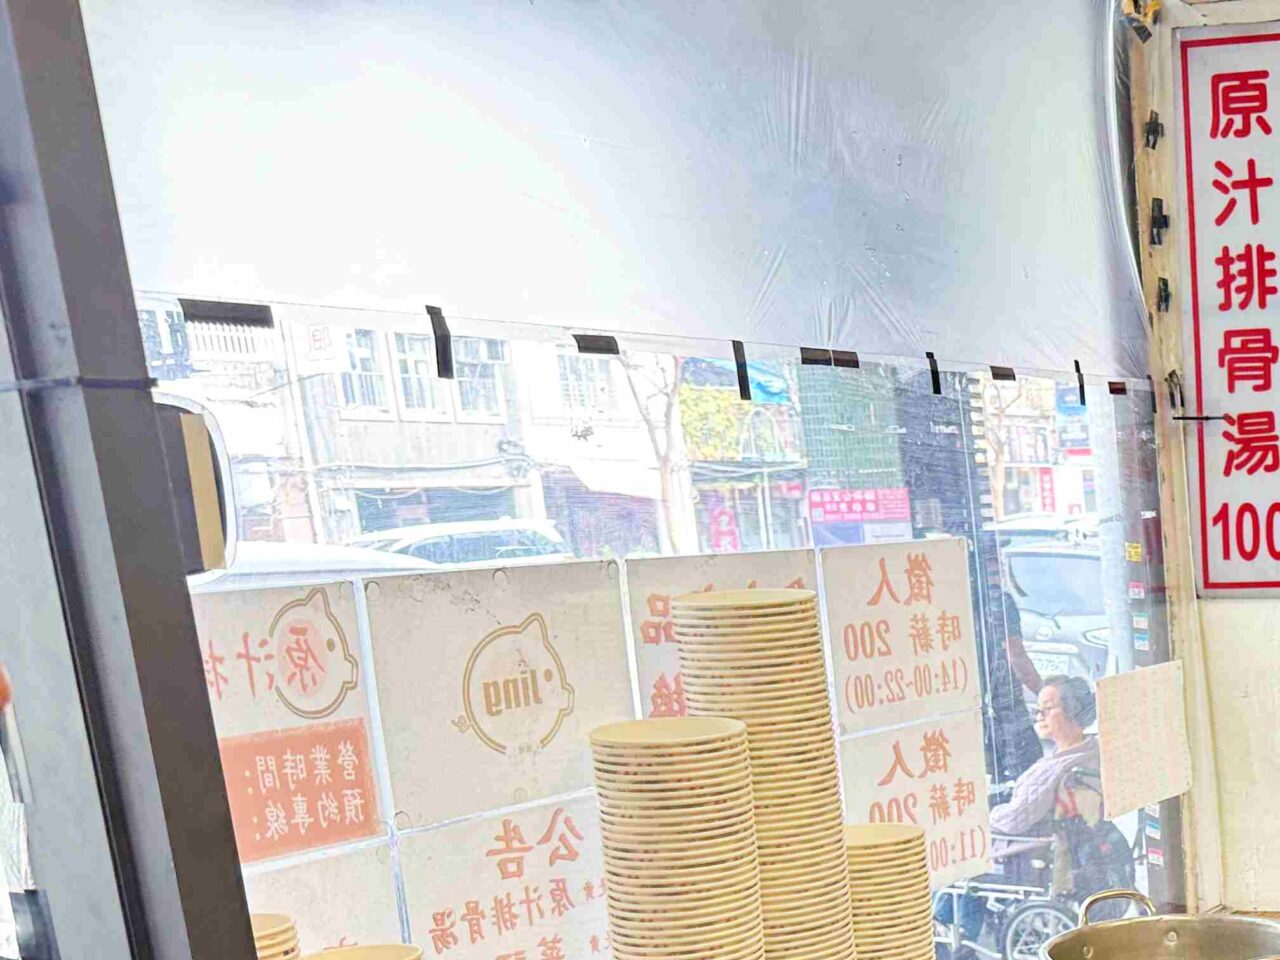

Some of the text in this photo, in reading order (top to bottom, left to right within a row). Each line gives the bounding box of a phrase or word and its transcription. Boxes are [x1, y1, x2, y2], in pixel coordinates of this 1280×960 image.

[1209, 70, 1280, 478] 原汁排骨湯
